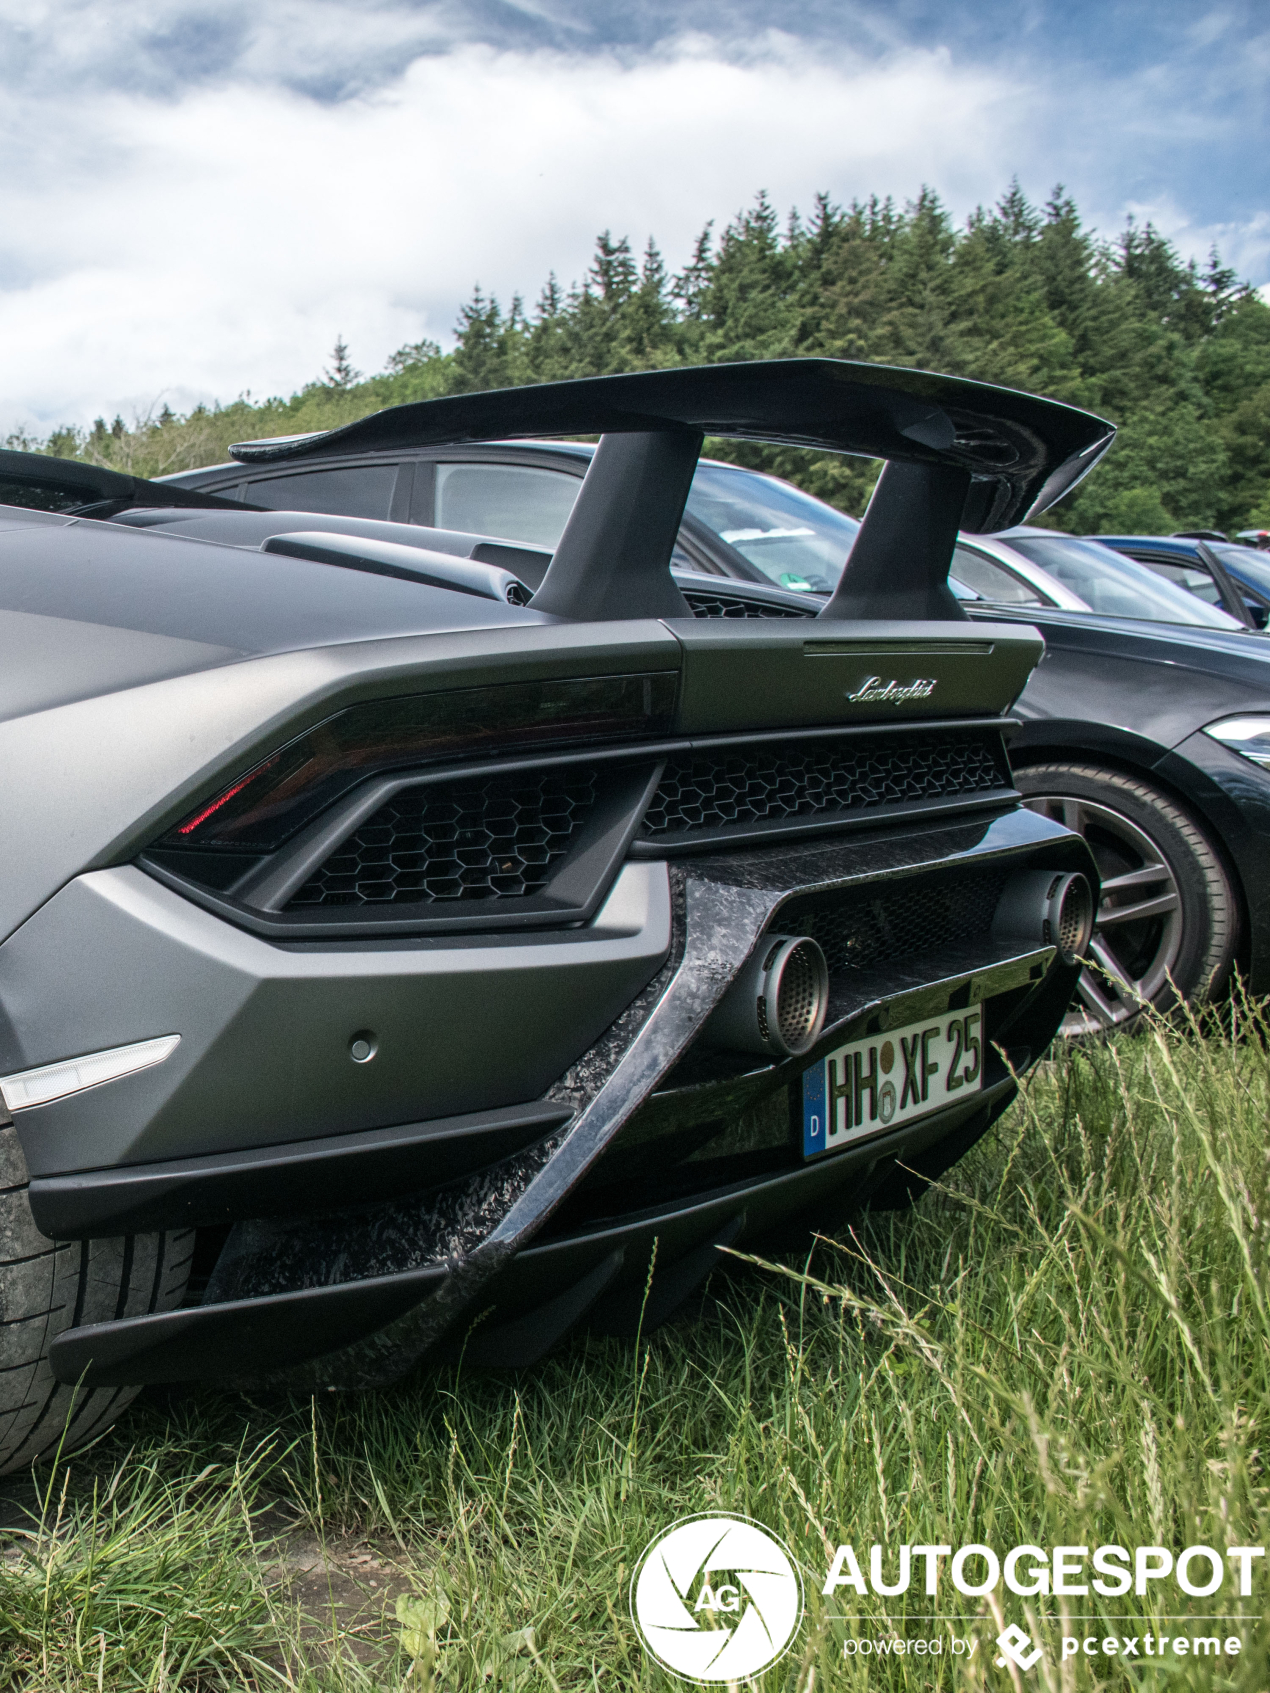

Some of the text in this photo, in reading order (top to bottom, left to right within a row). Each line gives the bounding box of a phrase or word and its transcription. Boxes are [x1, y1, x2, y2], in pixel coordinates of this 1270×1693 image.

[848, 676, 938, 706] Lamborghini
[828, 1012, 981, 1136] HH XF 25
[810, 1115, 819, 1137] D
